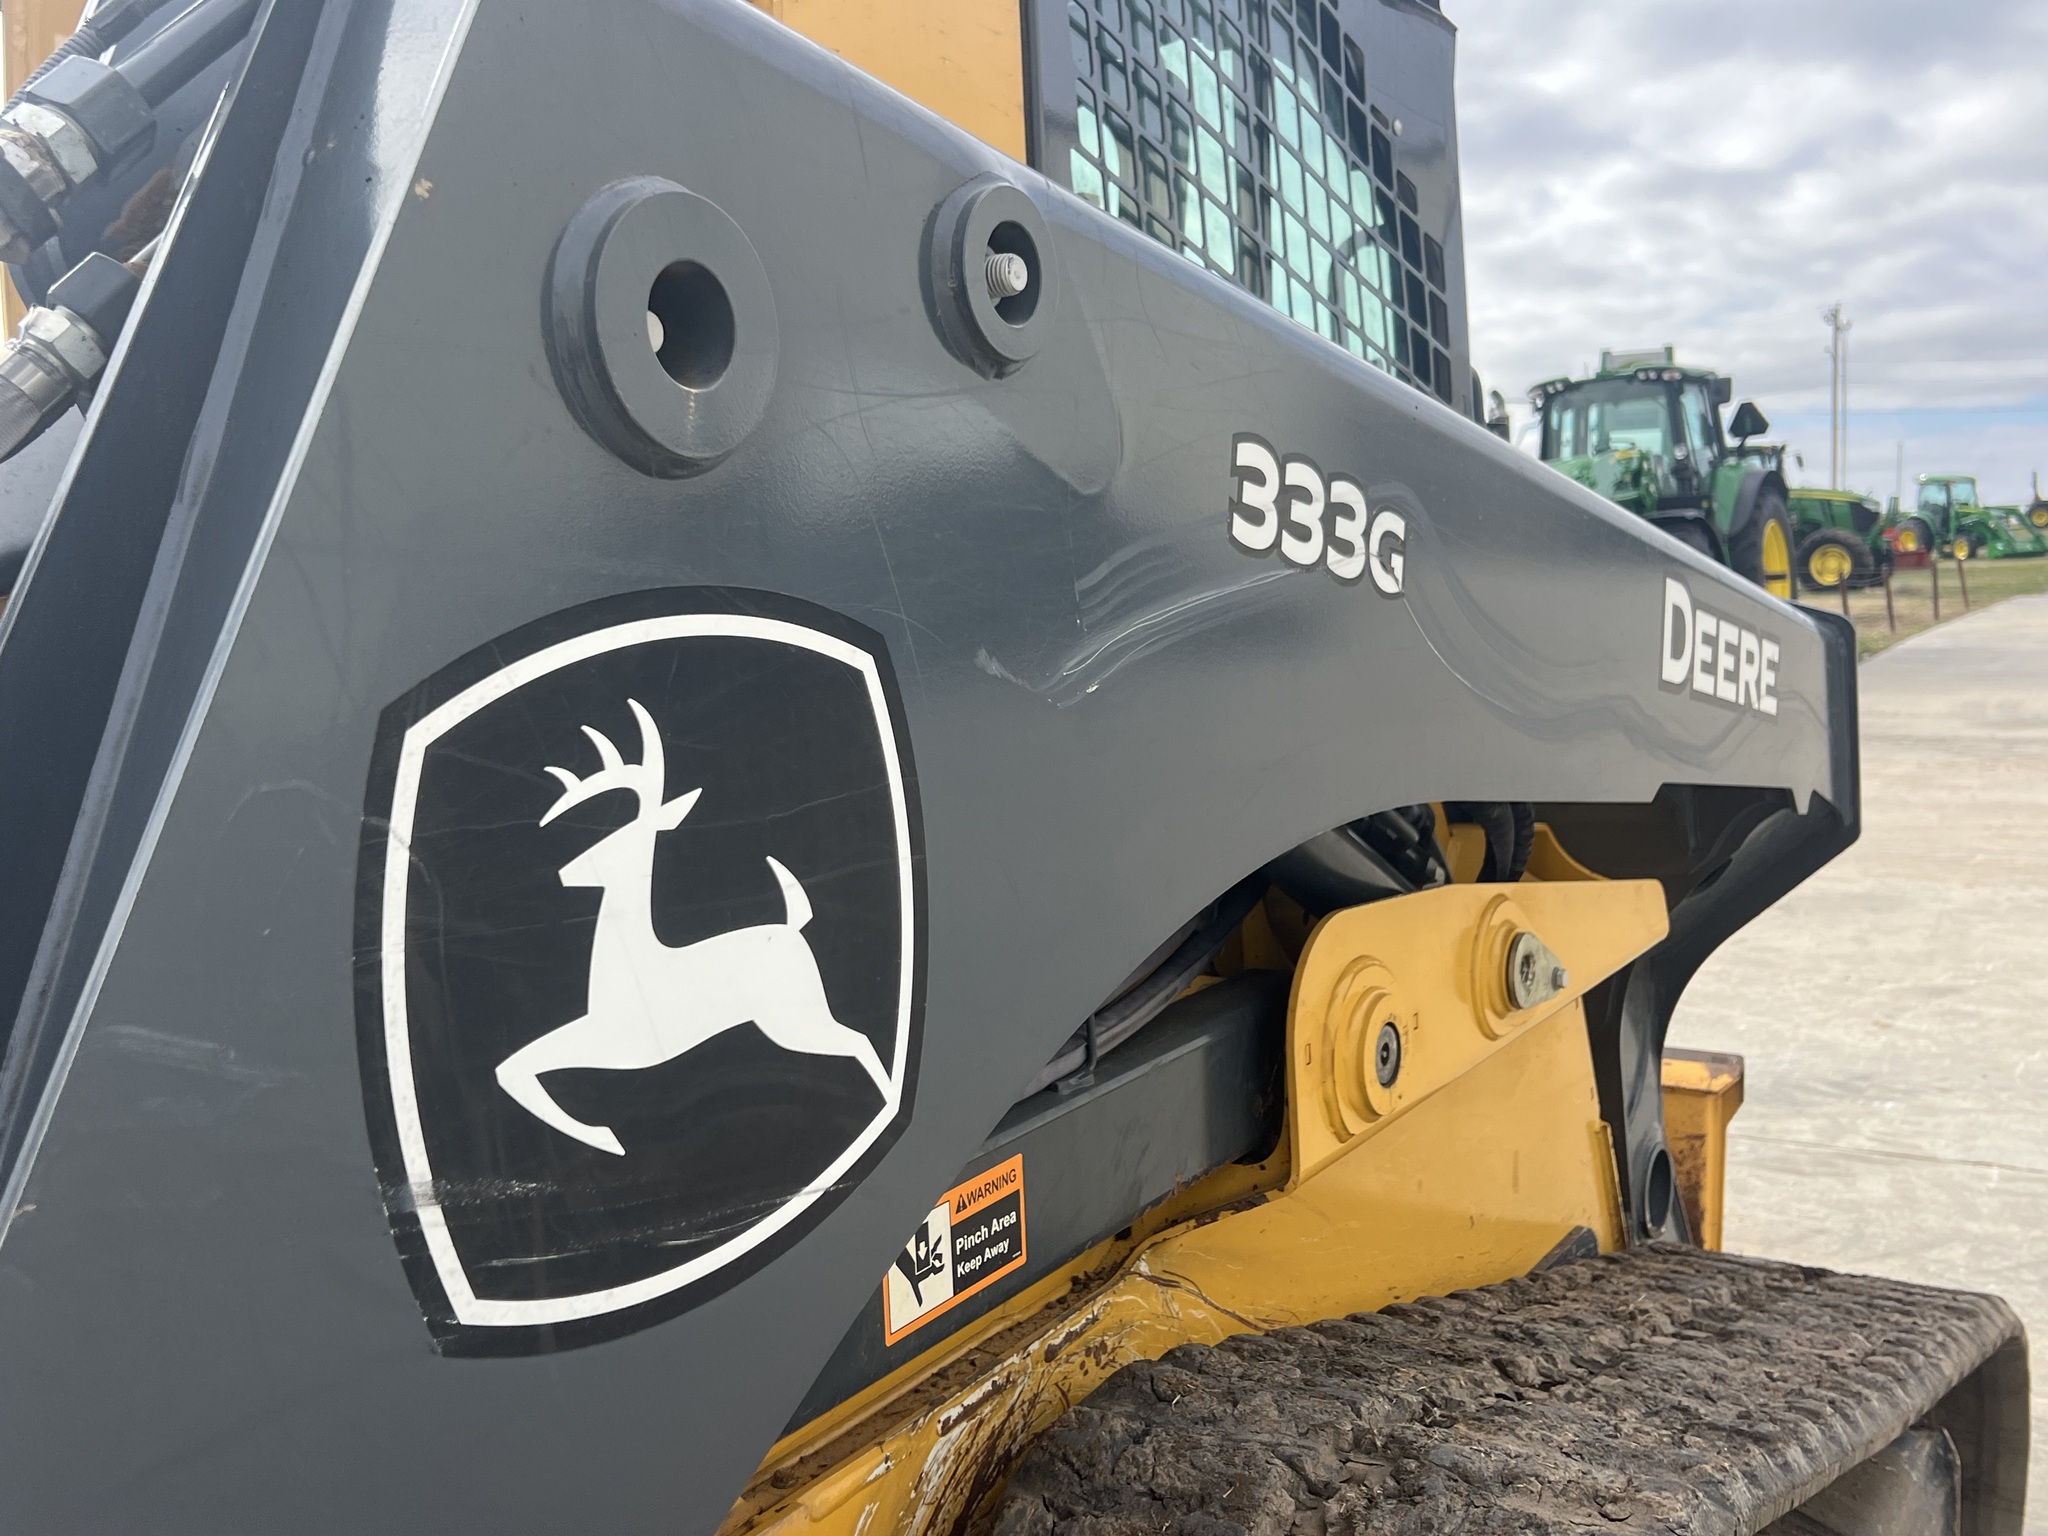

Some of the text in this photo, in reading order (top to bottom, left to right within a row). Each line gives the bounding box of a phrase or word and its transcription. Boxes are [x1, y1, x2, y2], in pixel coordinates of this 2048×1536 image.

[1232, 442, 1406, 594] 333G
[1661, 576, 1780, 716] DEERE
[967, 1169, 1017, 1206] WARNING
[956, 1211, 1017, 1255] Pinch Area
[957, 1238, 1010, 1277] Keep Away
